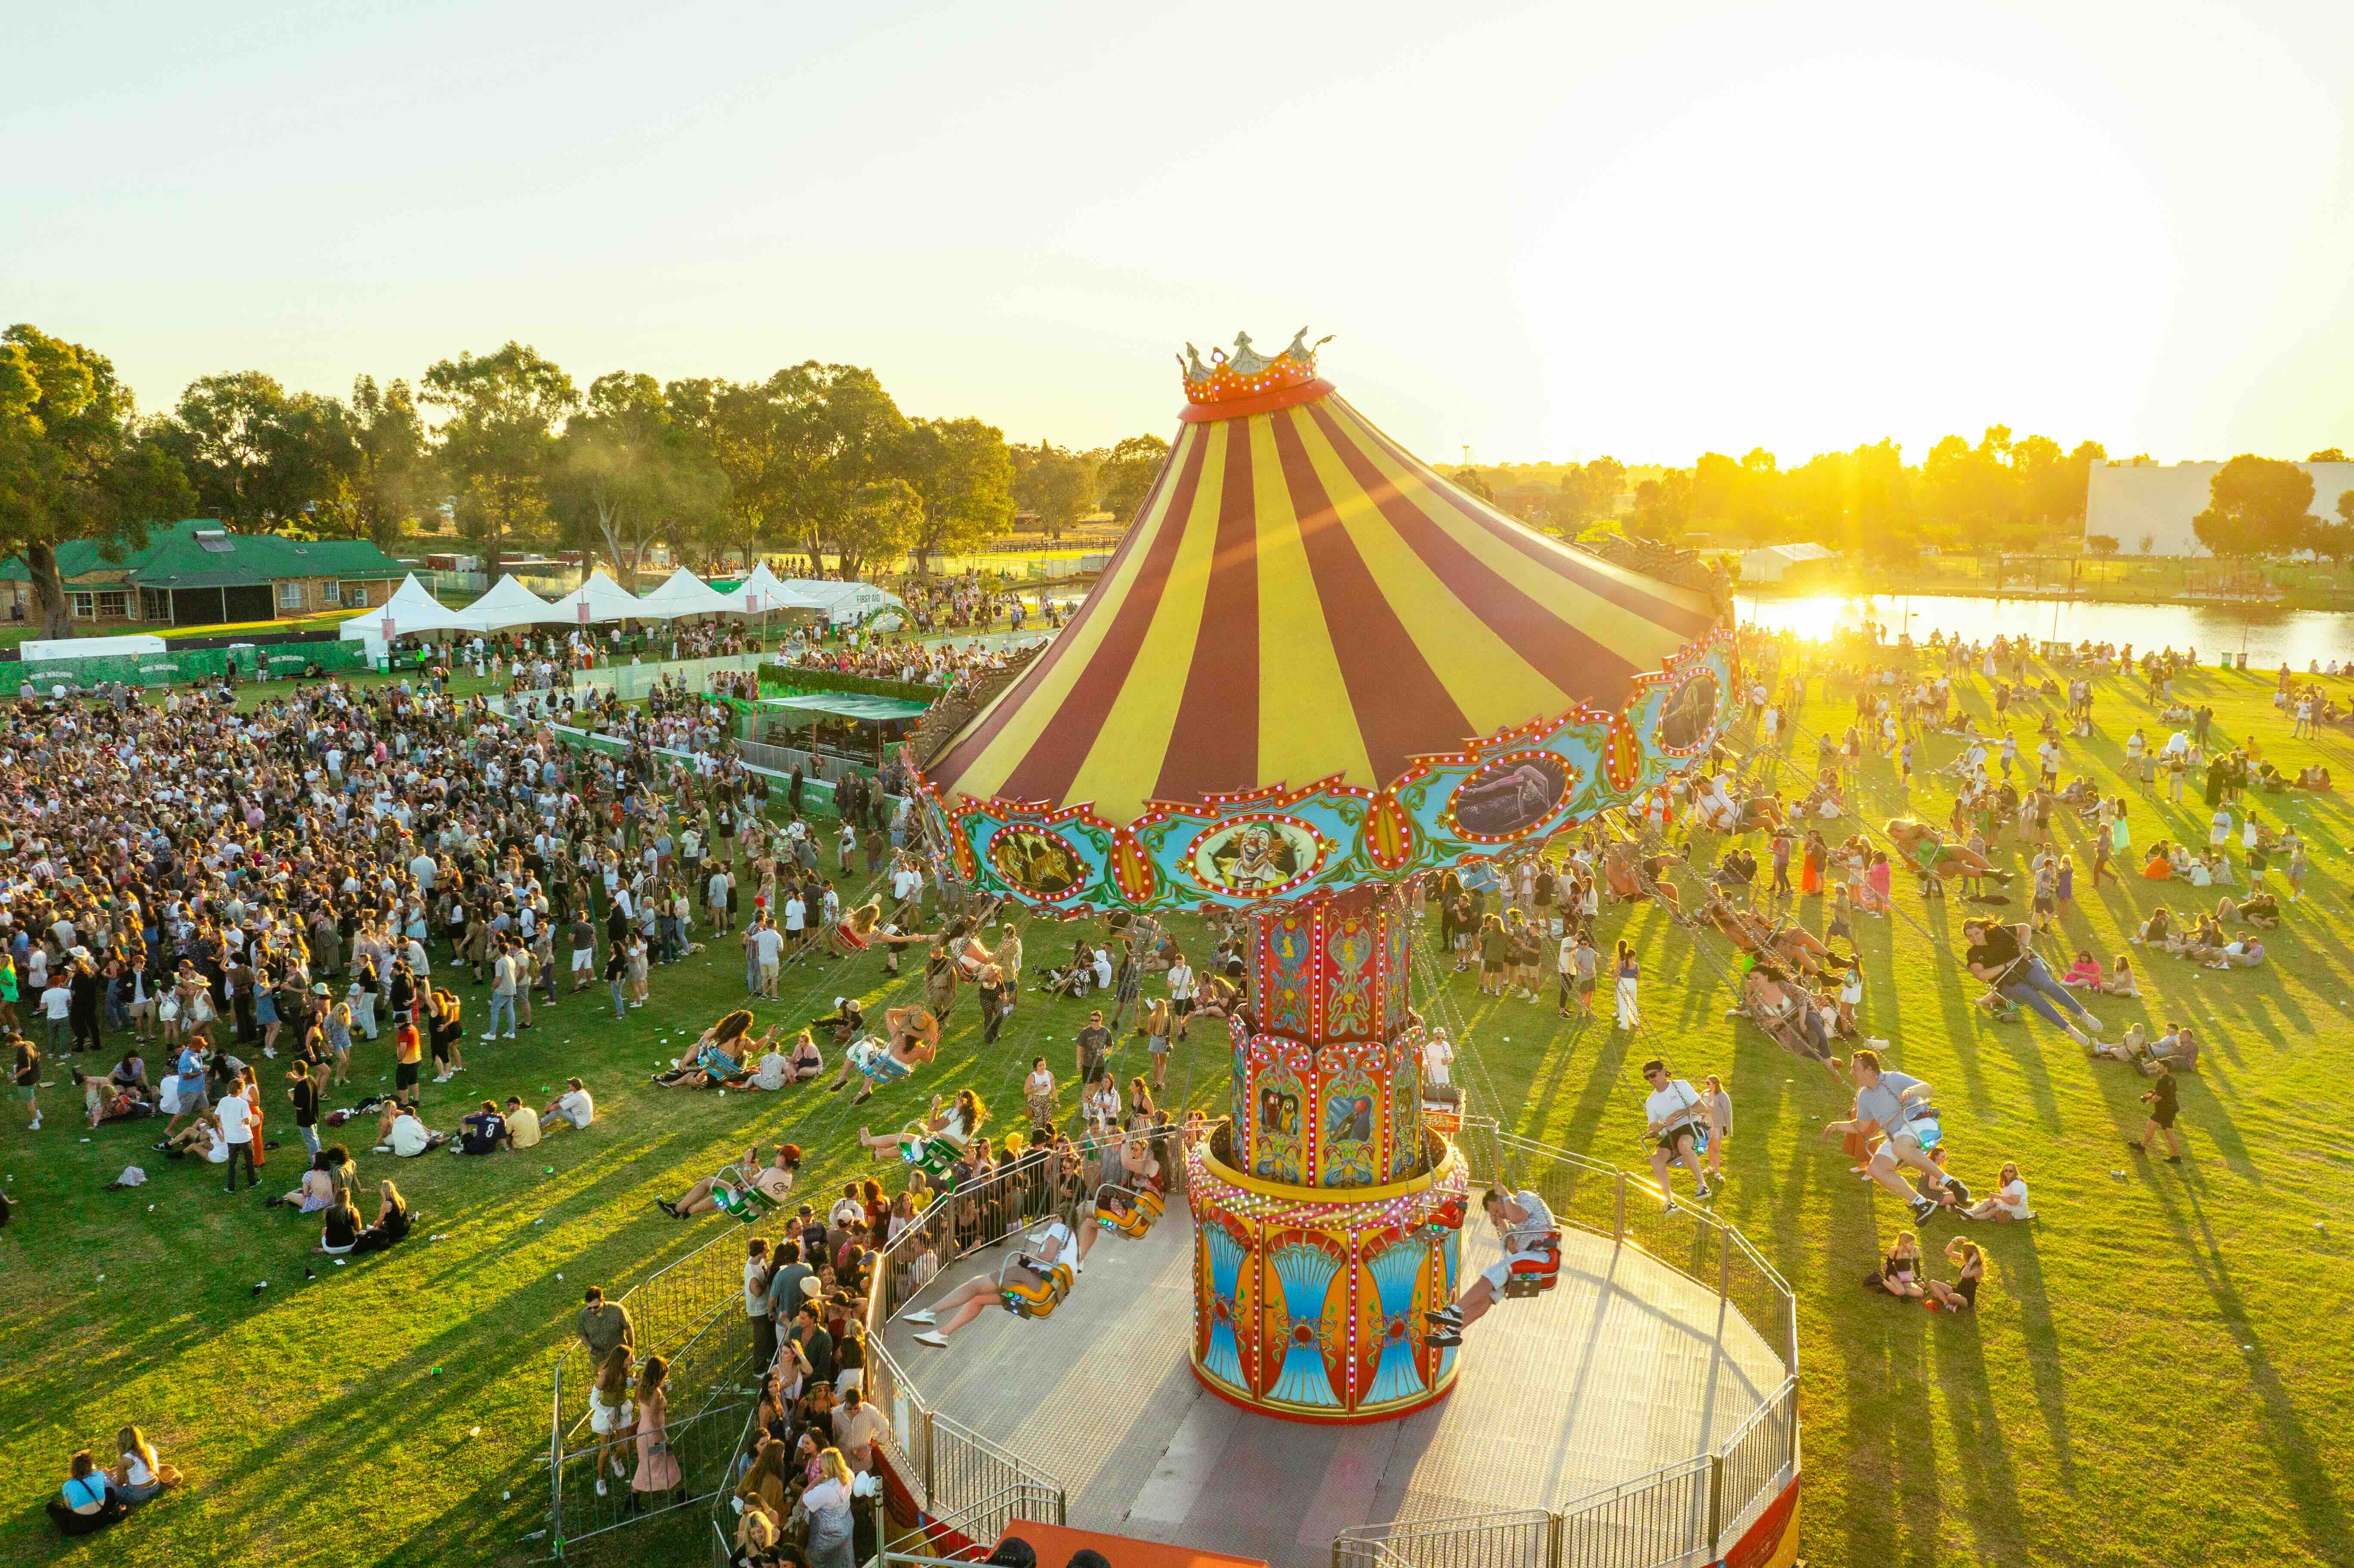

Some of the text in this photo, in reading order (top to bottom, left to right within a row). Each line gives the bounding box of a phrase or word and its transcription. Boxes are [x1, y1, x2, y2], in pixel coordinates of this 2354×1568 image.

[857, 594, 880, 604] FIRST AID
[486, 1123, 495, 1138] 8
